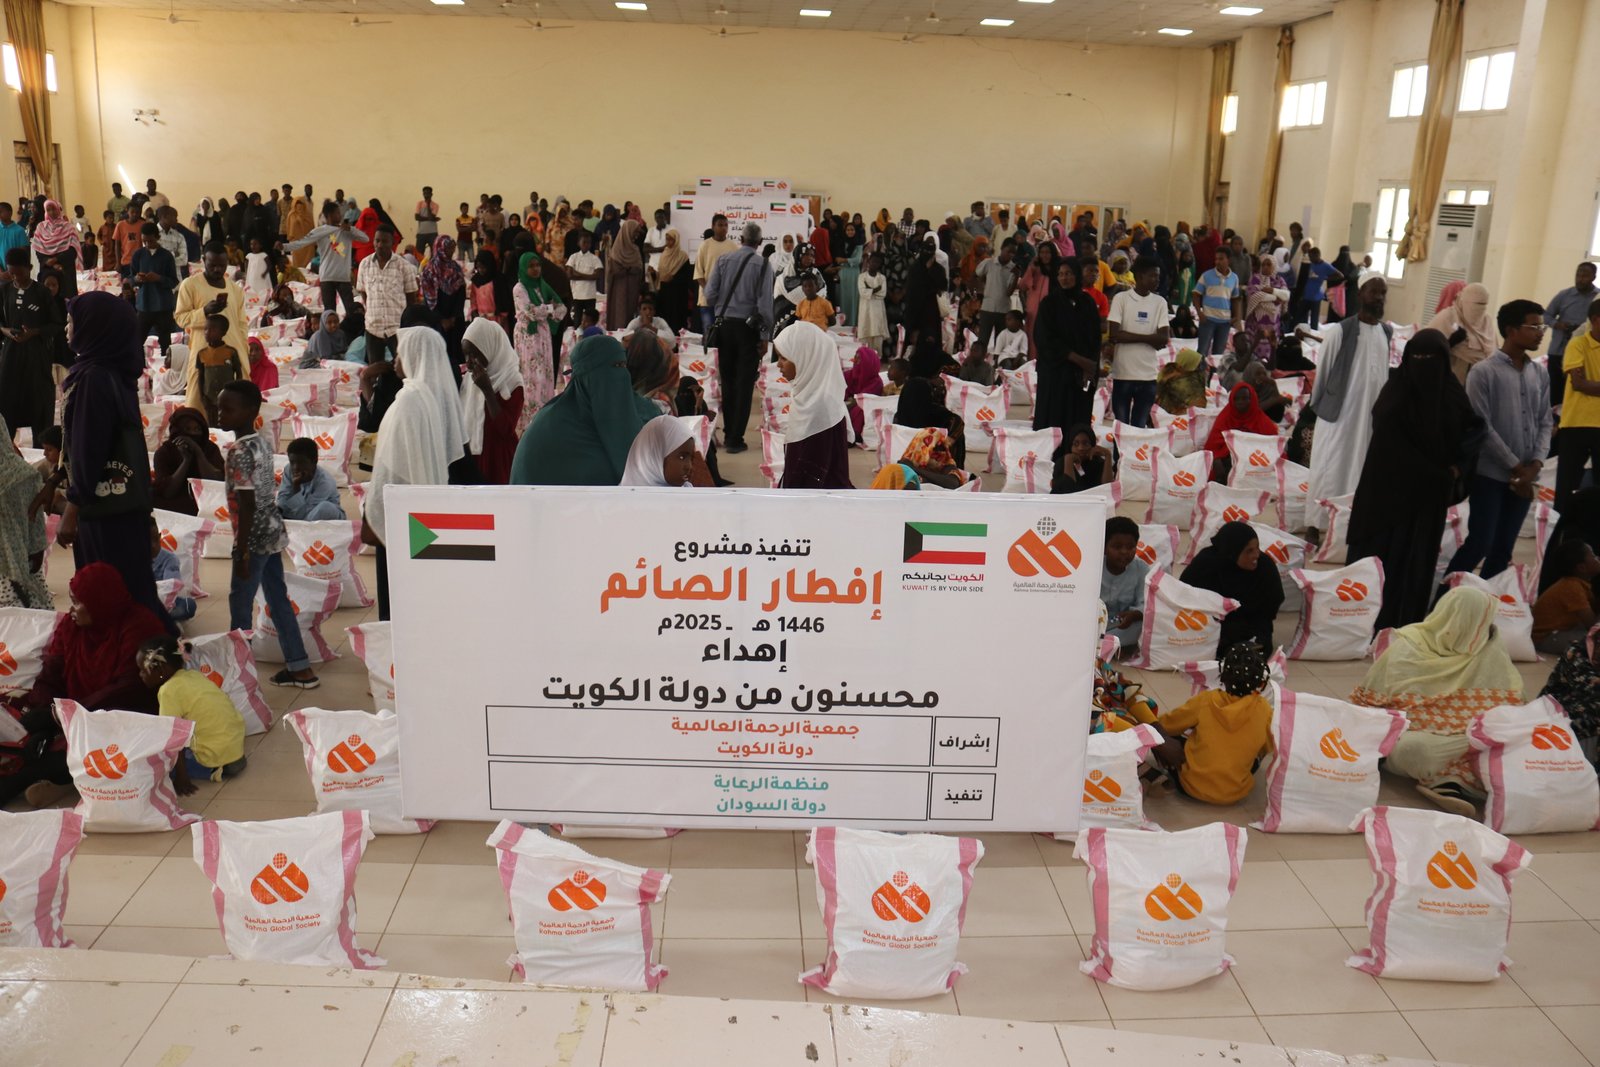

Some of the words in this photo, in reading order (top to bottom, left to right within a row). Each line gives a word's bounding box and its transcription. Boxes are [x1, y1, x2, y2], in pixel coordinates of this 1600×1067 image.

[744, 211, 767, 222] إفطار
[674, 534, 752, 562] مشروع
[755, 538, 810, 561] تنفيذ
[600, 557, 748, 614] الصائم
[902, 572, 947, 582] بجانبكم
[948, 573, 984, 582] الكويت
[762, 567, 882, 620] إفطار
[658, 614, 722, 635] 2025م
[778, 616, 824, 633] 1446
[702, 638, 787, 672] إهداء
[542, 676, 651, 708] الكويت
[659, 676, 727, 709] دولة
[736, 682, 782, 711] من
[791, 680, 940, 713] محسنون
[671, 716, 742, 734] العالمية
[745, 718, 800, 738] الرحمة
[803, 719, 860, 739] جمعية
[717, 742, 775, 758] الكويت
[777, 742, 813, 758] دولة
[939, 734, 990, 752] إشراف
[714, 774, 769, 792] الرعاية
[771, 775, 829, 791] منظمة
[716, 797, 787, 814] السودان
[790, 798, 826, 814] دولة
[945, 790, 983, 805] تنفيذ
[244, 915, 271, 924] العالمية
[296, 913, 320, 921] جمعية
[296, 921, 320, 929] Society
[591, 917, 615, 925] جمعية
[591, 924, 615, 932] Society
[863, 929, 891, 940] العالمية
[862, 937, 886, 947] Rahma
